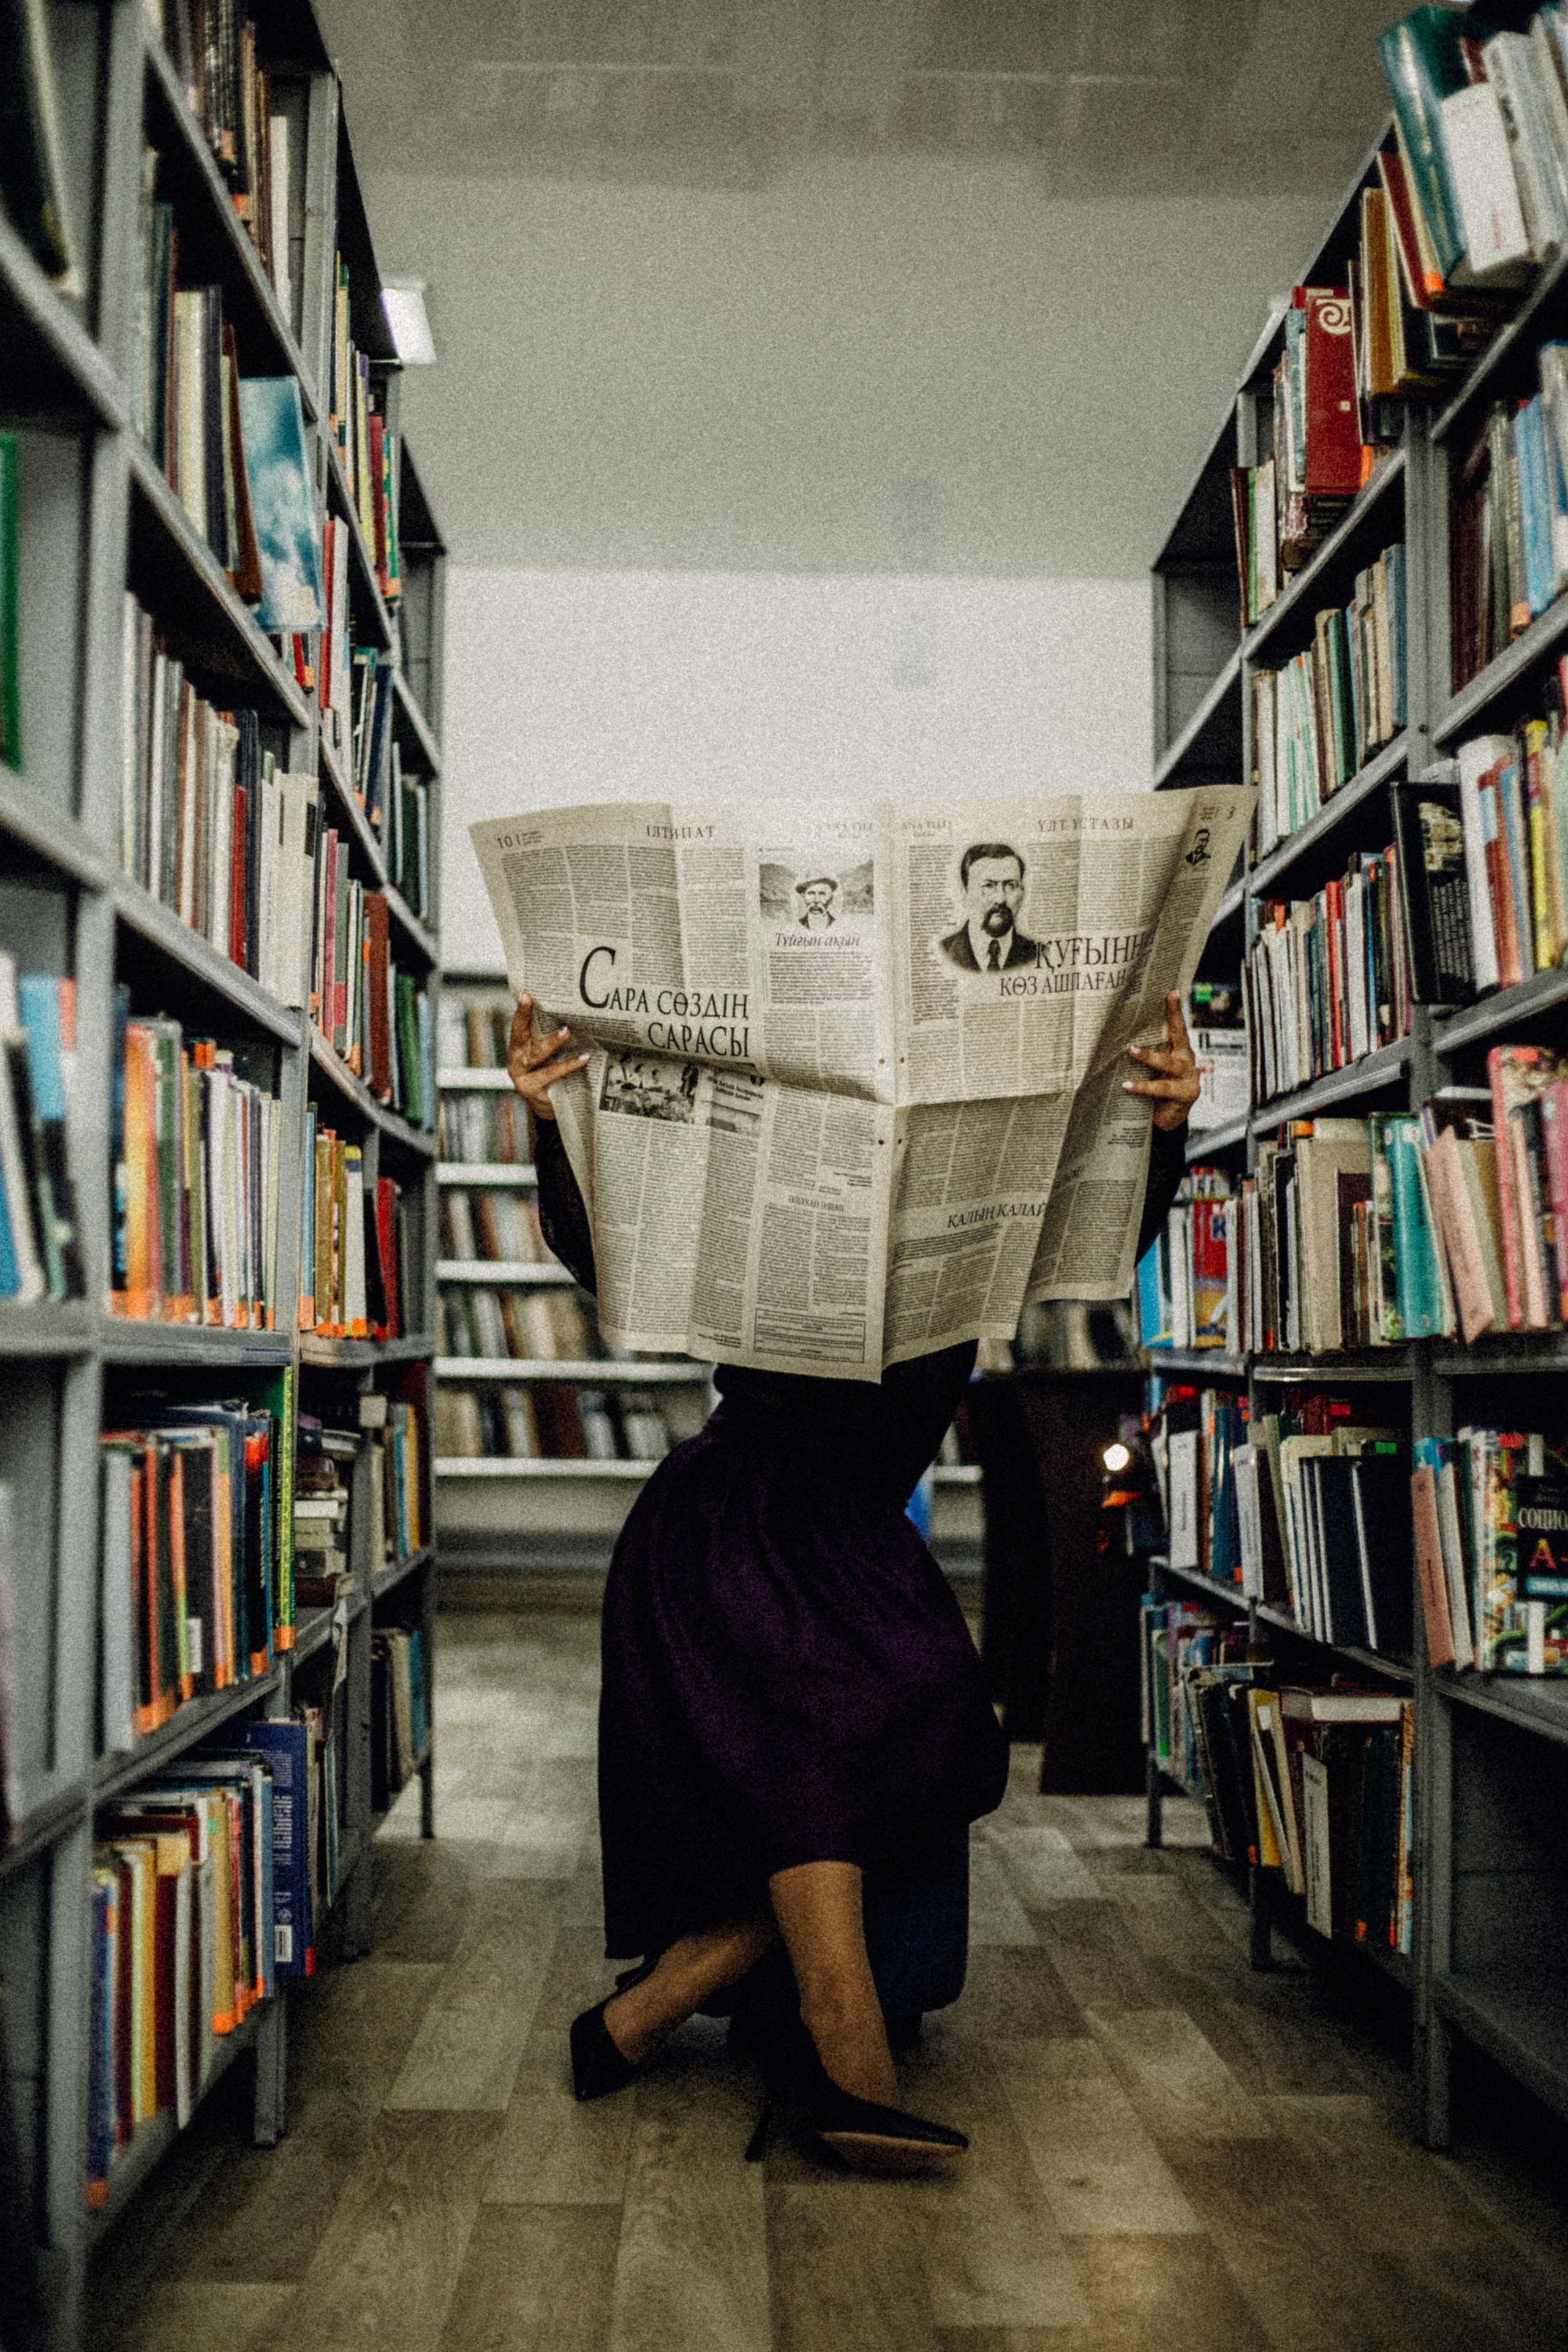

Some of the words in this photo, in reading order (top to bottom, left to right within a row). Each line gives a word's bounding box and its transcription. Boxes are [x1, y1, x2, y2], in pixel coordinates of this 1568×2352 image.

[497, 835, 513, 850] 10
[1000, 976, 1038, 997] КӨЗ
[647, 1022, 750, 1057] САРАСЫ
